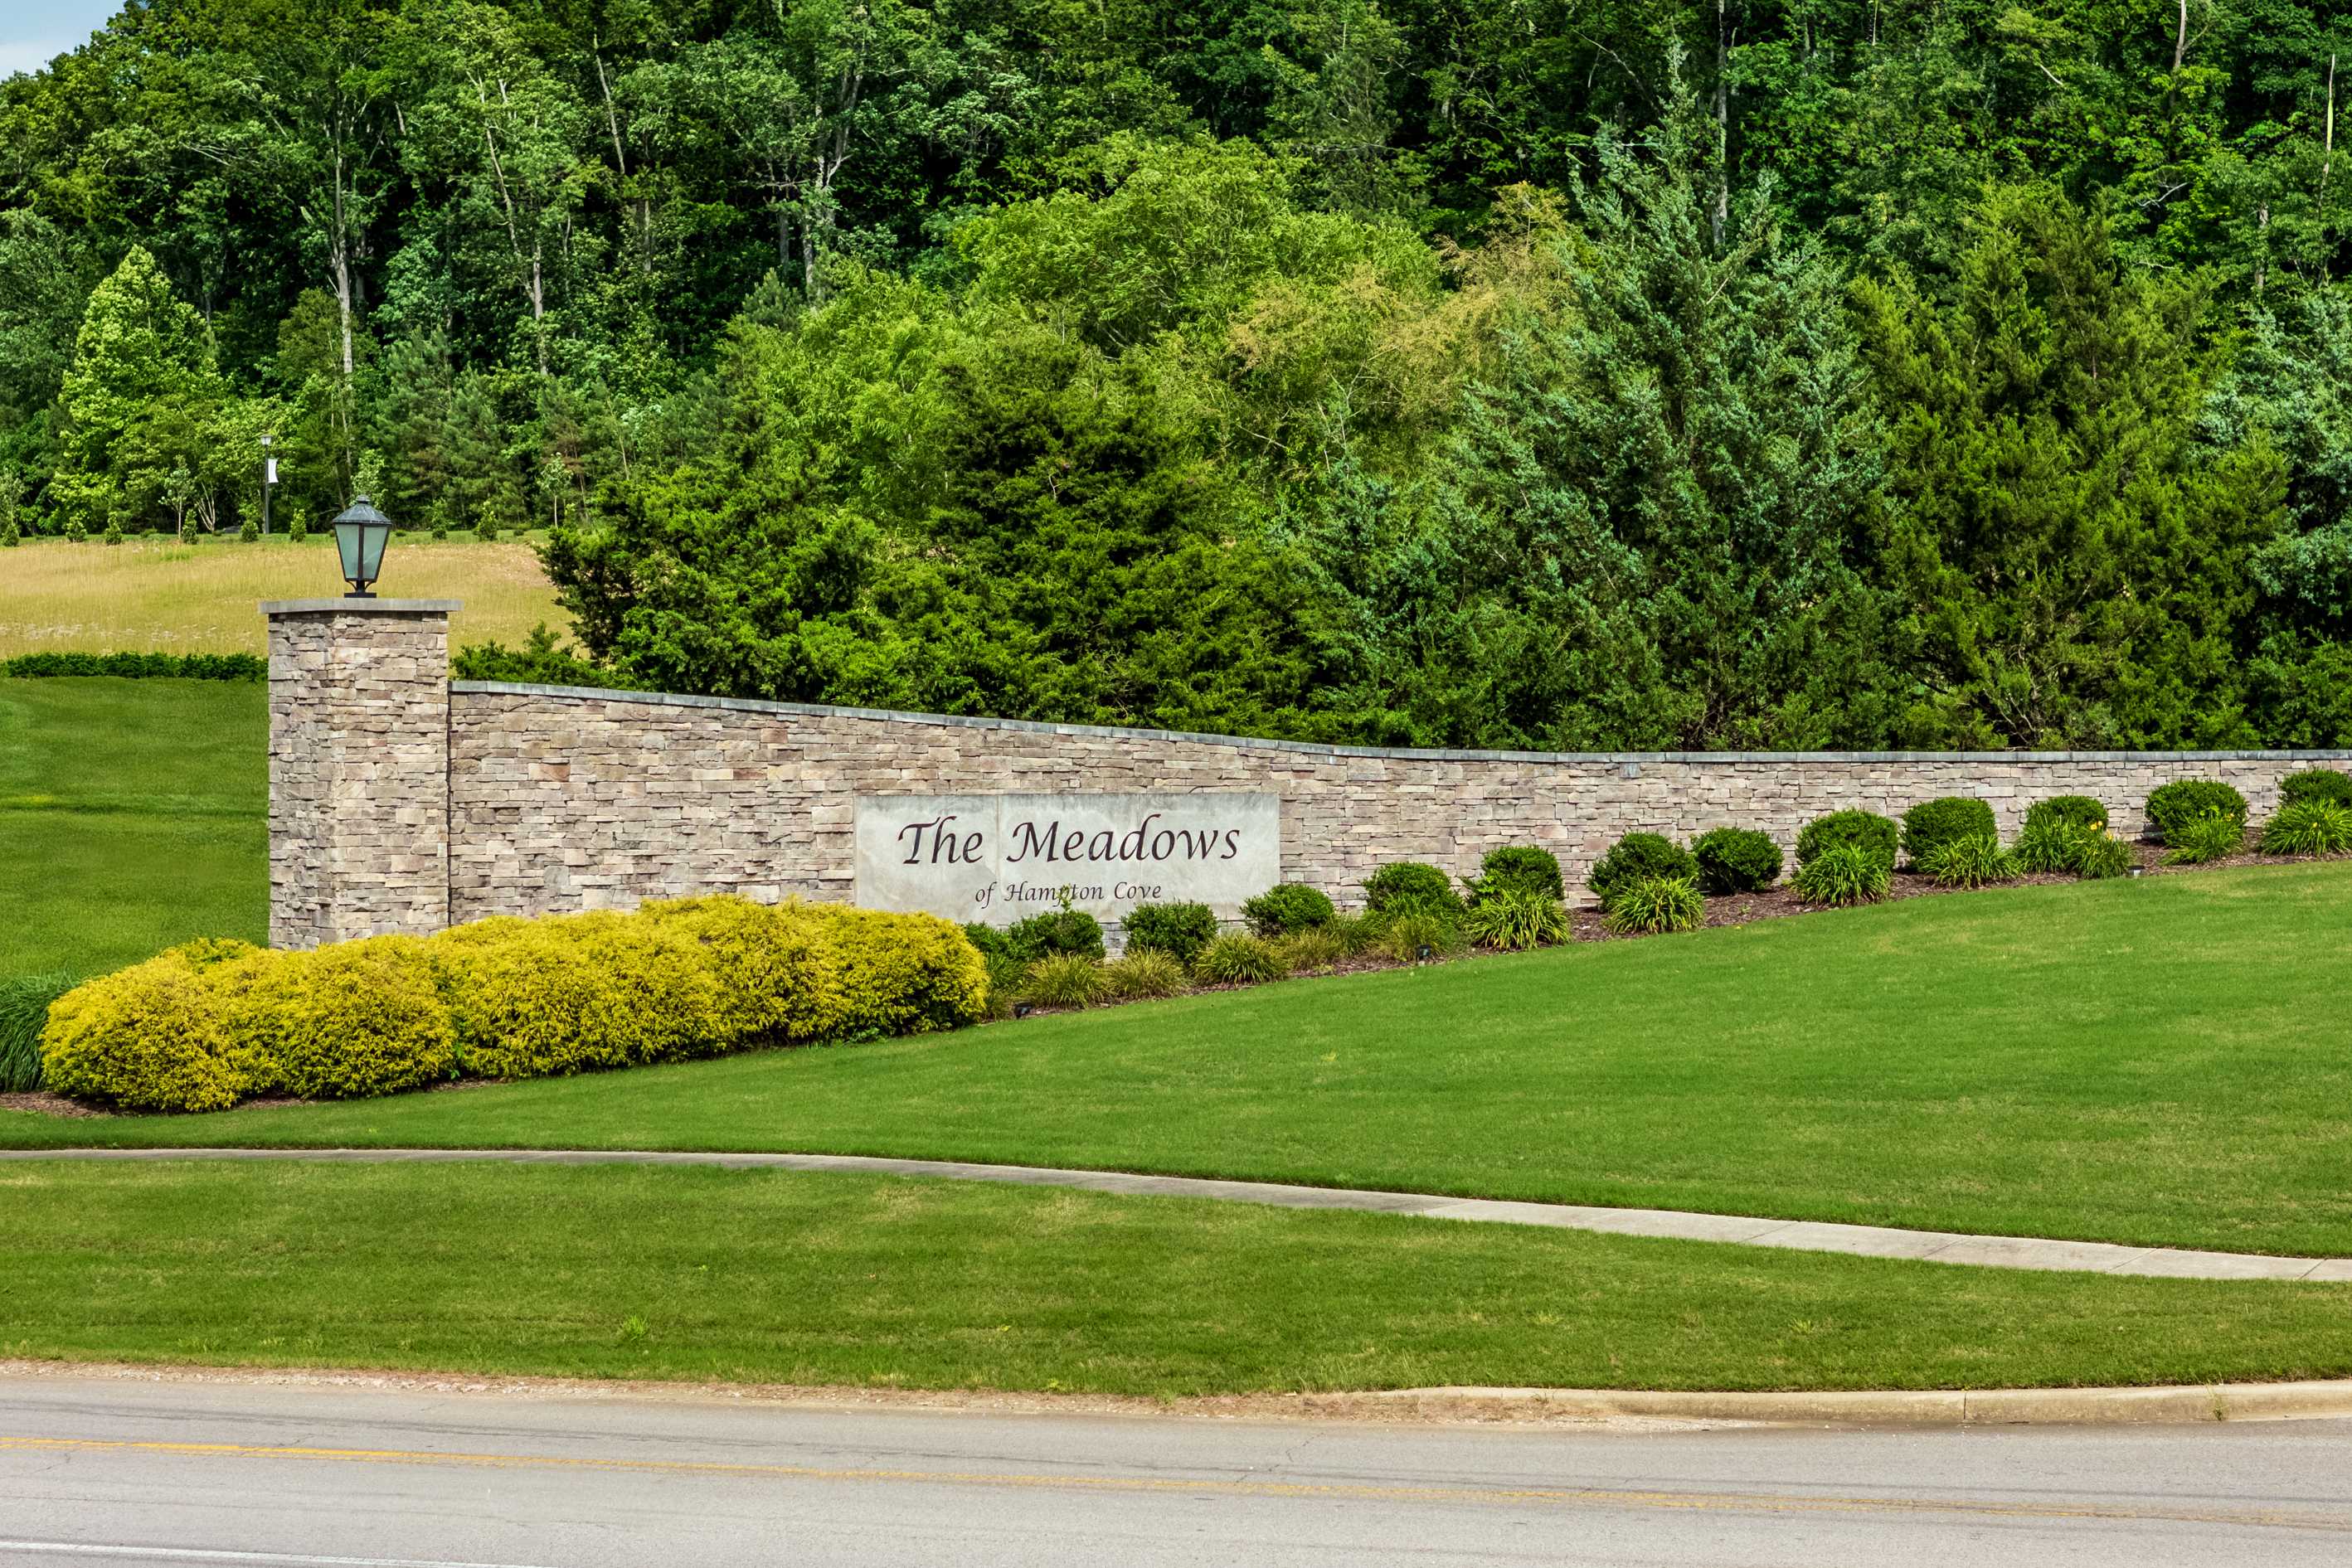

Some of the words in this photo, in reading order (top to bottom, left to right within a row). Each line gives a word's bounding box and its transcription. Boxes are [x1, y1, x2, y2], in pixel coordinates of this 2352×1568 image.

[897, 815, 984, 865] The
[1005, 813, 1241, 863] Meadows
[974, 881, 998, 910] of
[1114, 881, 1162, 901] Cove
